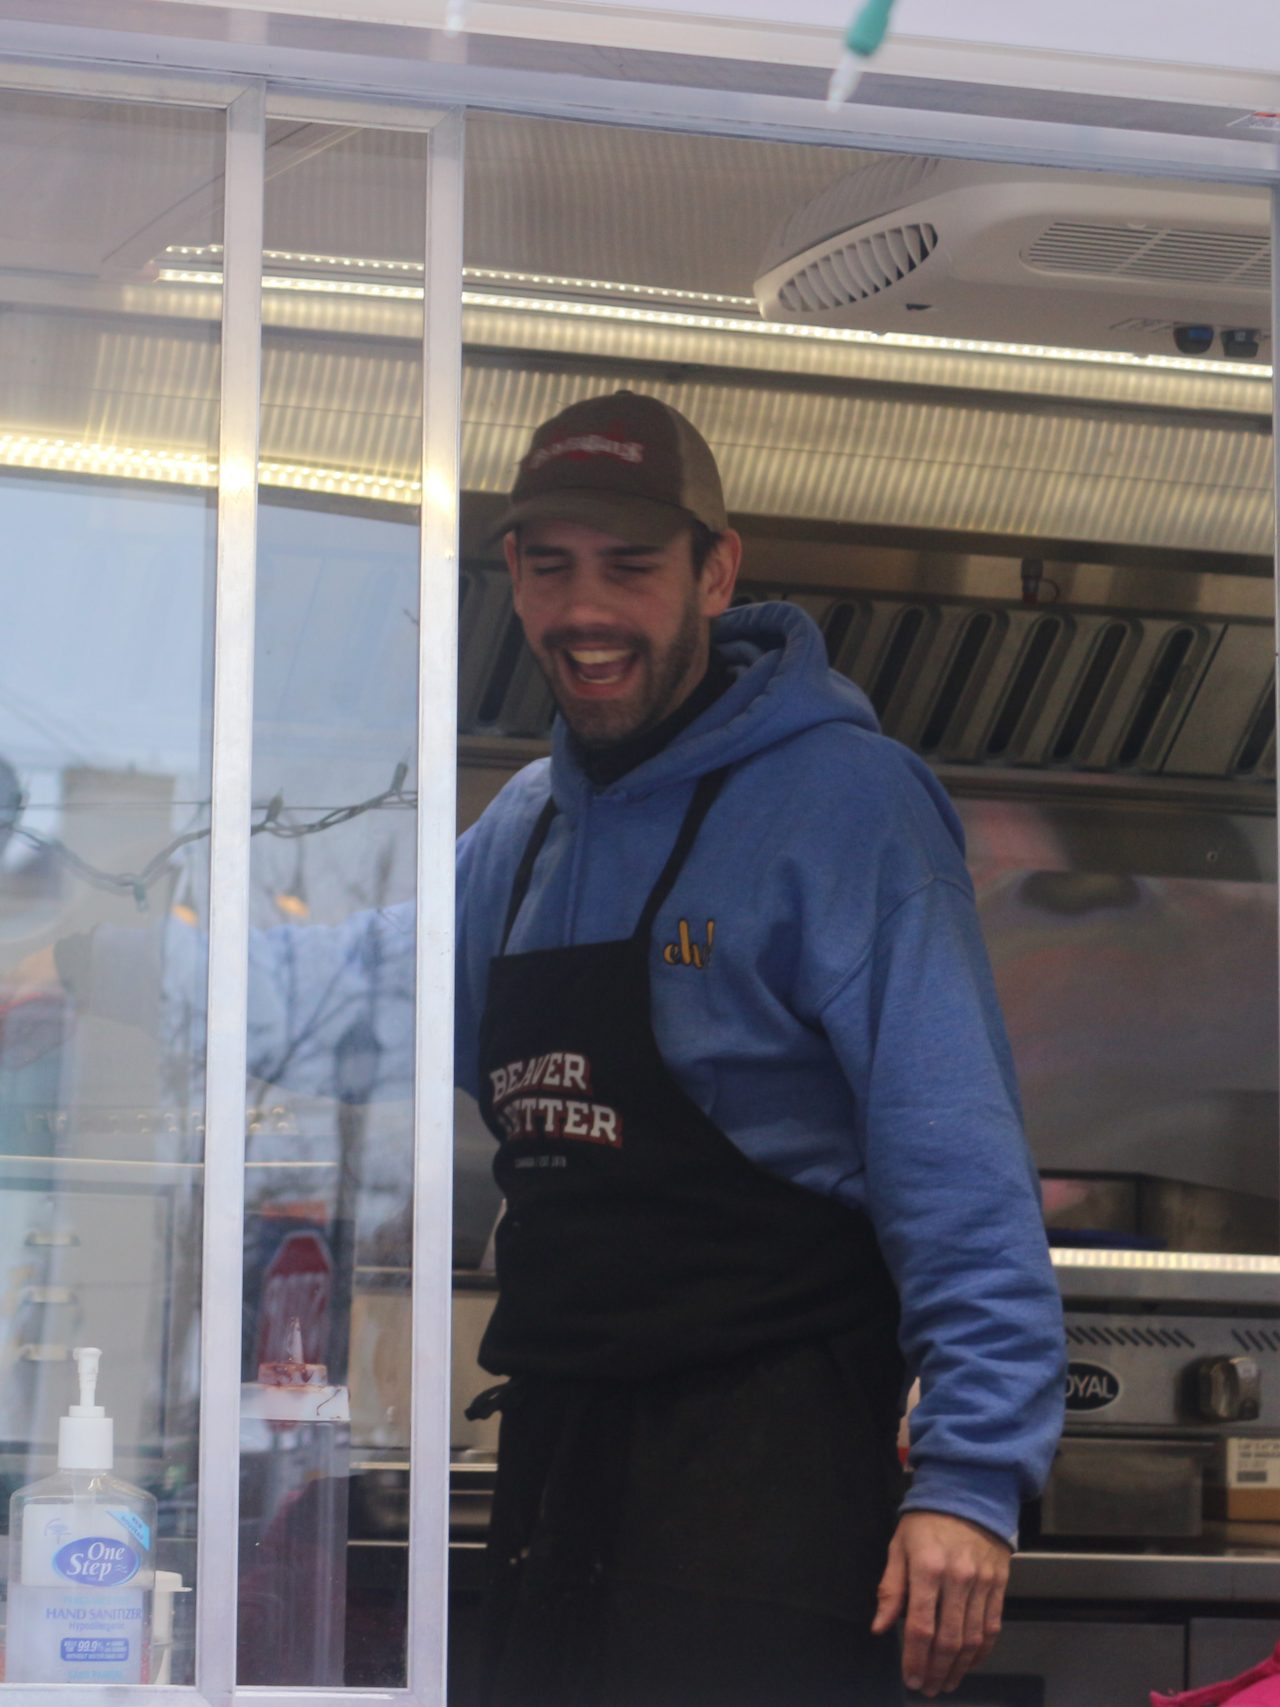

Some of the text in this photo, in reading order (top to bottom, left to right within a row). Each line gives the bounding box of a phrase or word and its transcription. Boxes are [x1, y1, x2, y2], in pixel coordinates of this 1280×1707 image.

[489, 1052, 588, 1103] BEAVER
[87, 1542, 126, 1562] One
[66, 1552, 112, 1582] Step
[46, 1608, 143, 1620] HAND SANITIZER
